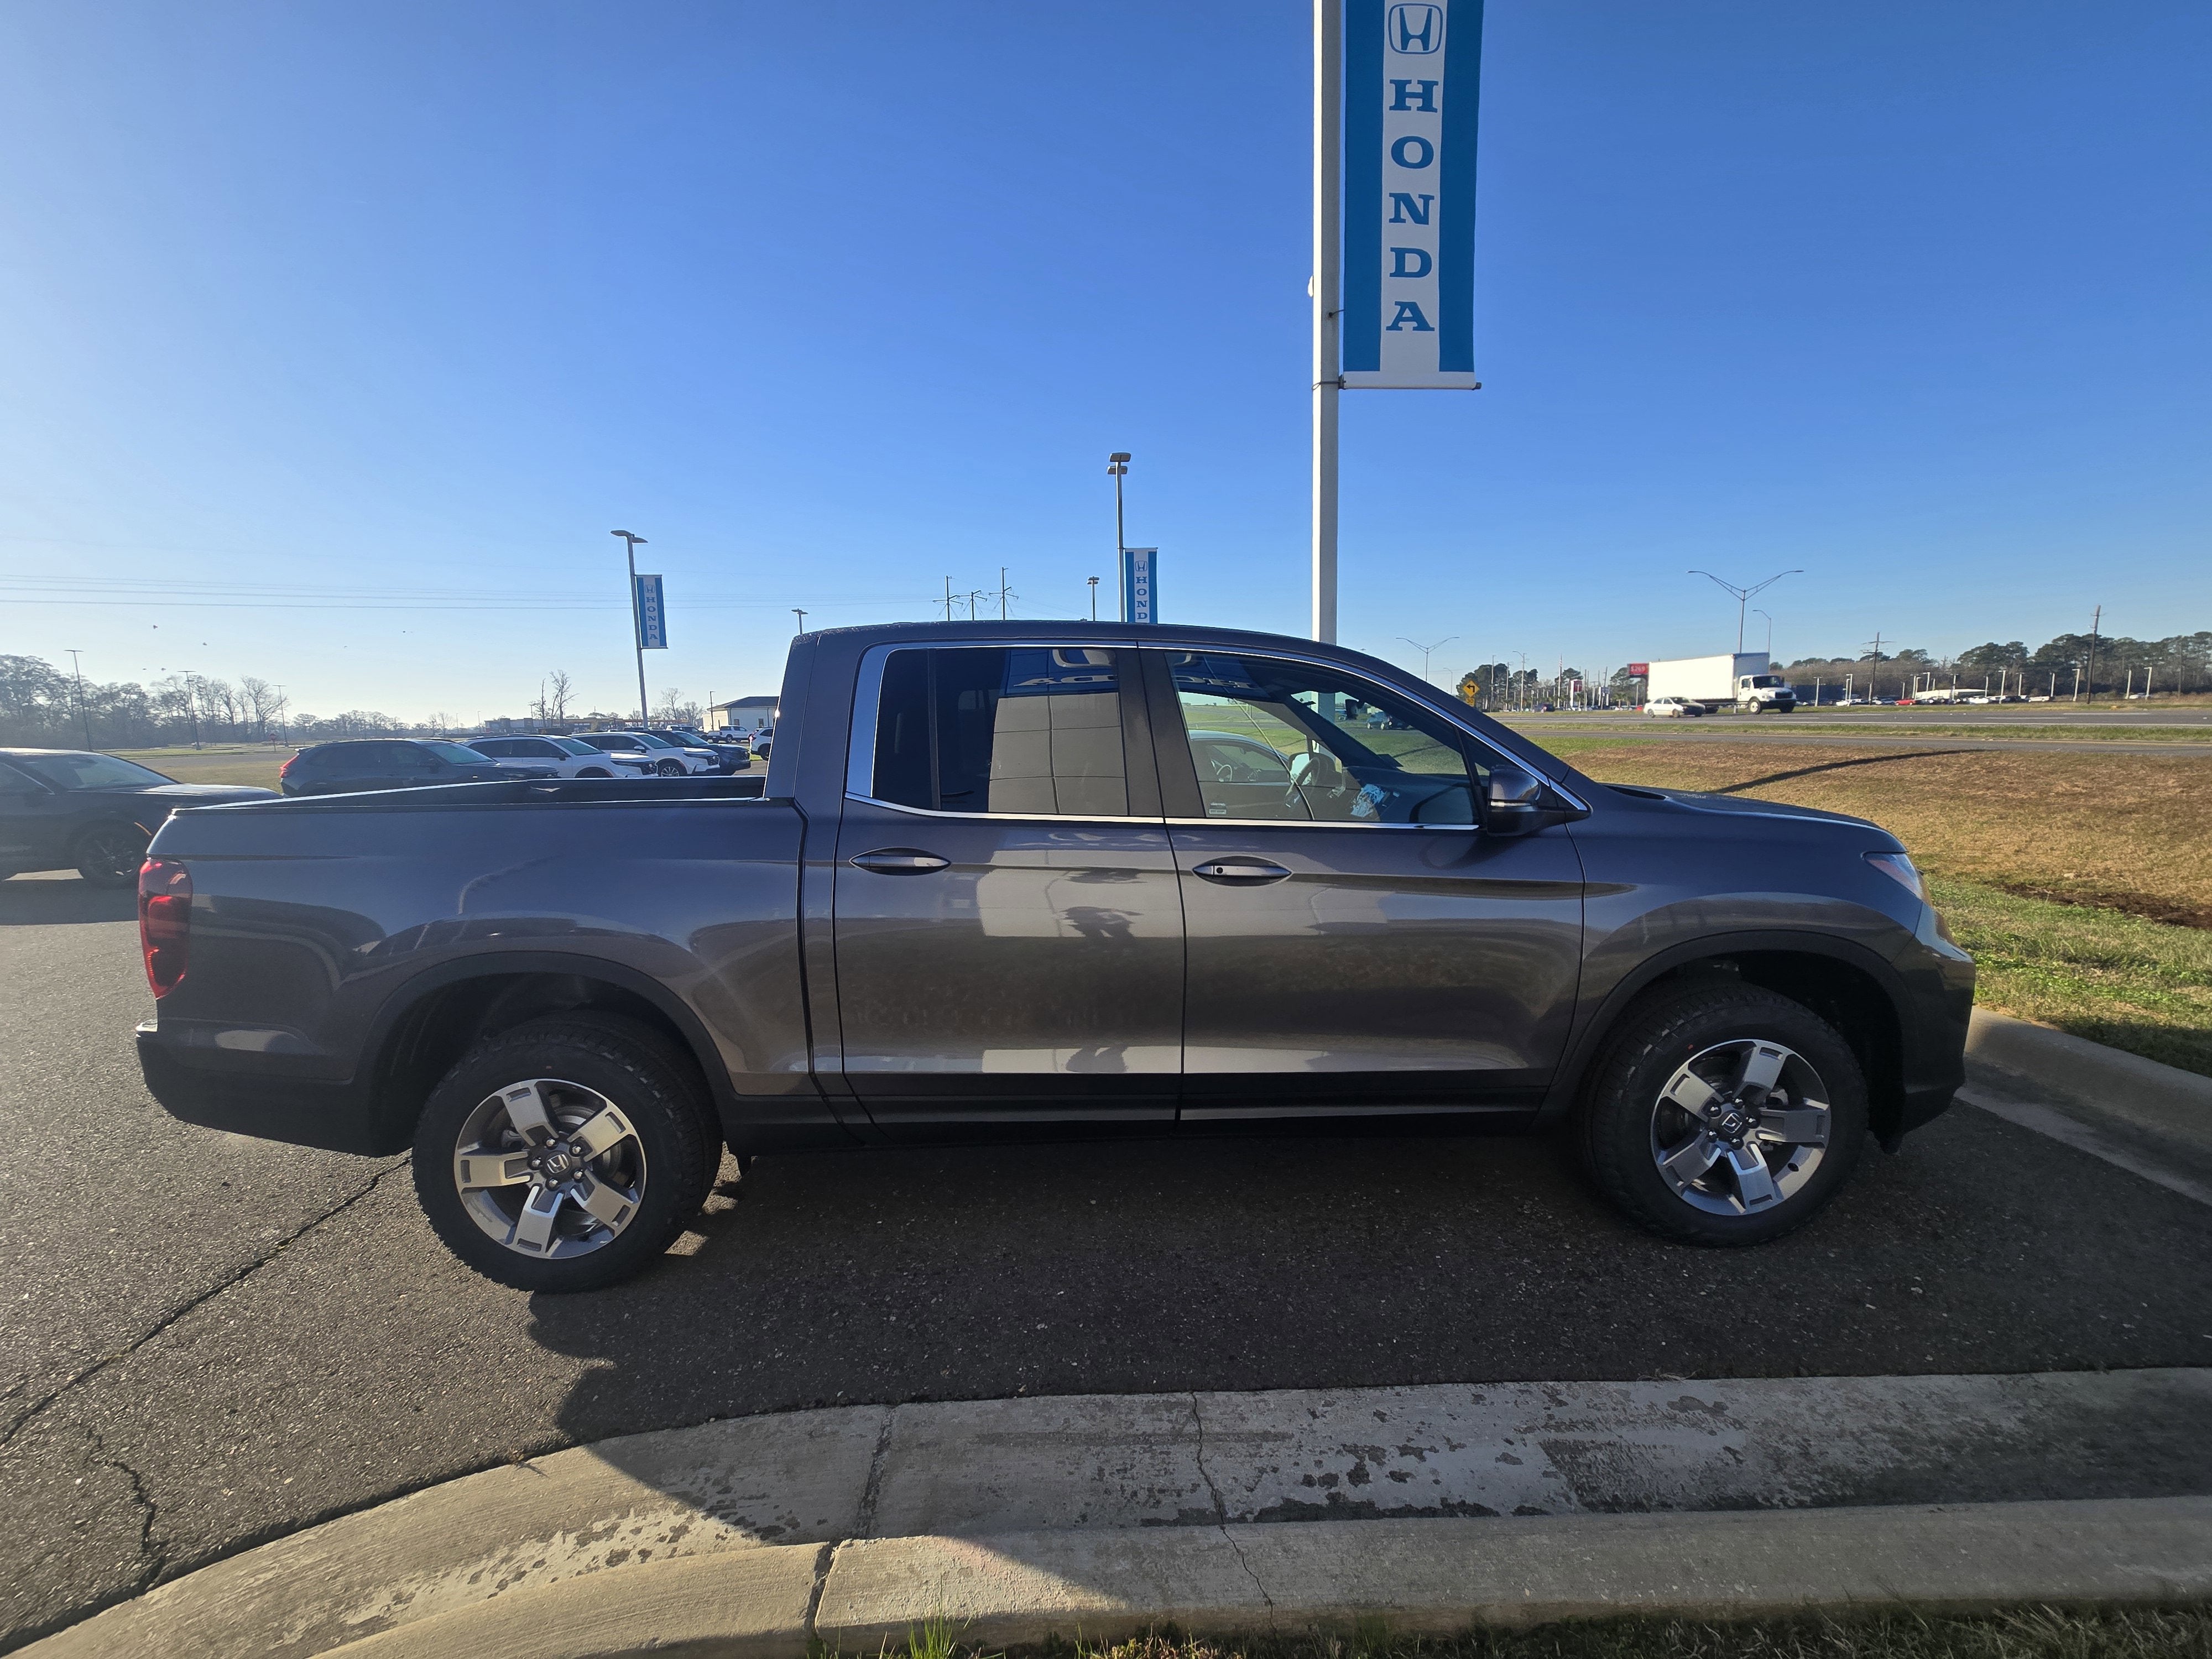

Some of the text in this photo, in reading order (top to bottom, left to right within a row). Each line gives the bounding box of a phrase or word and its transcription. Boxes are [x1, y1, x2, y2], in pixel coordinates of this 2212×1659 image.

[1386, 79, 1438, 332] HONDA
[646, 597, 659, 639] HONDA
[1135, 576, 1148, 620] HOND
